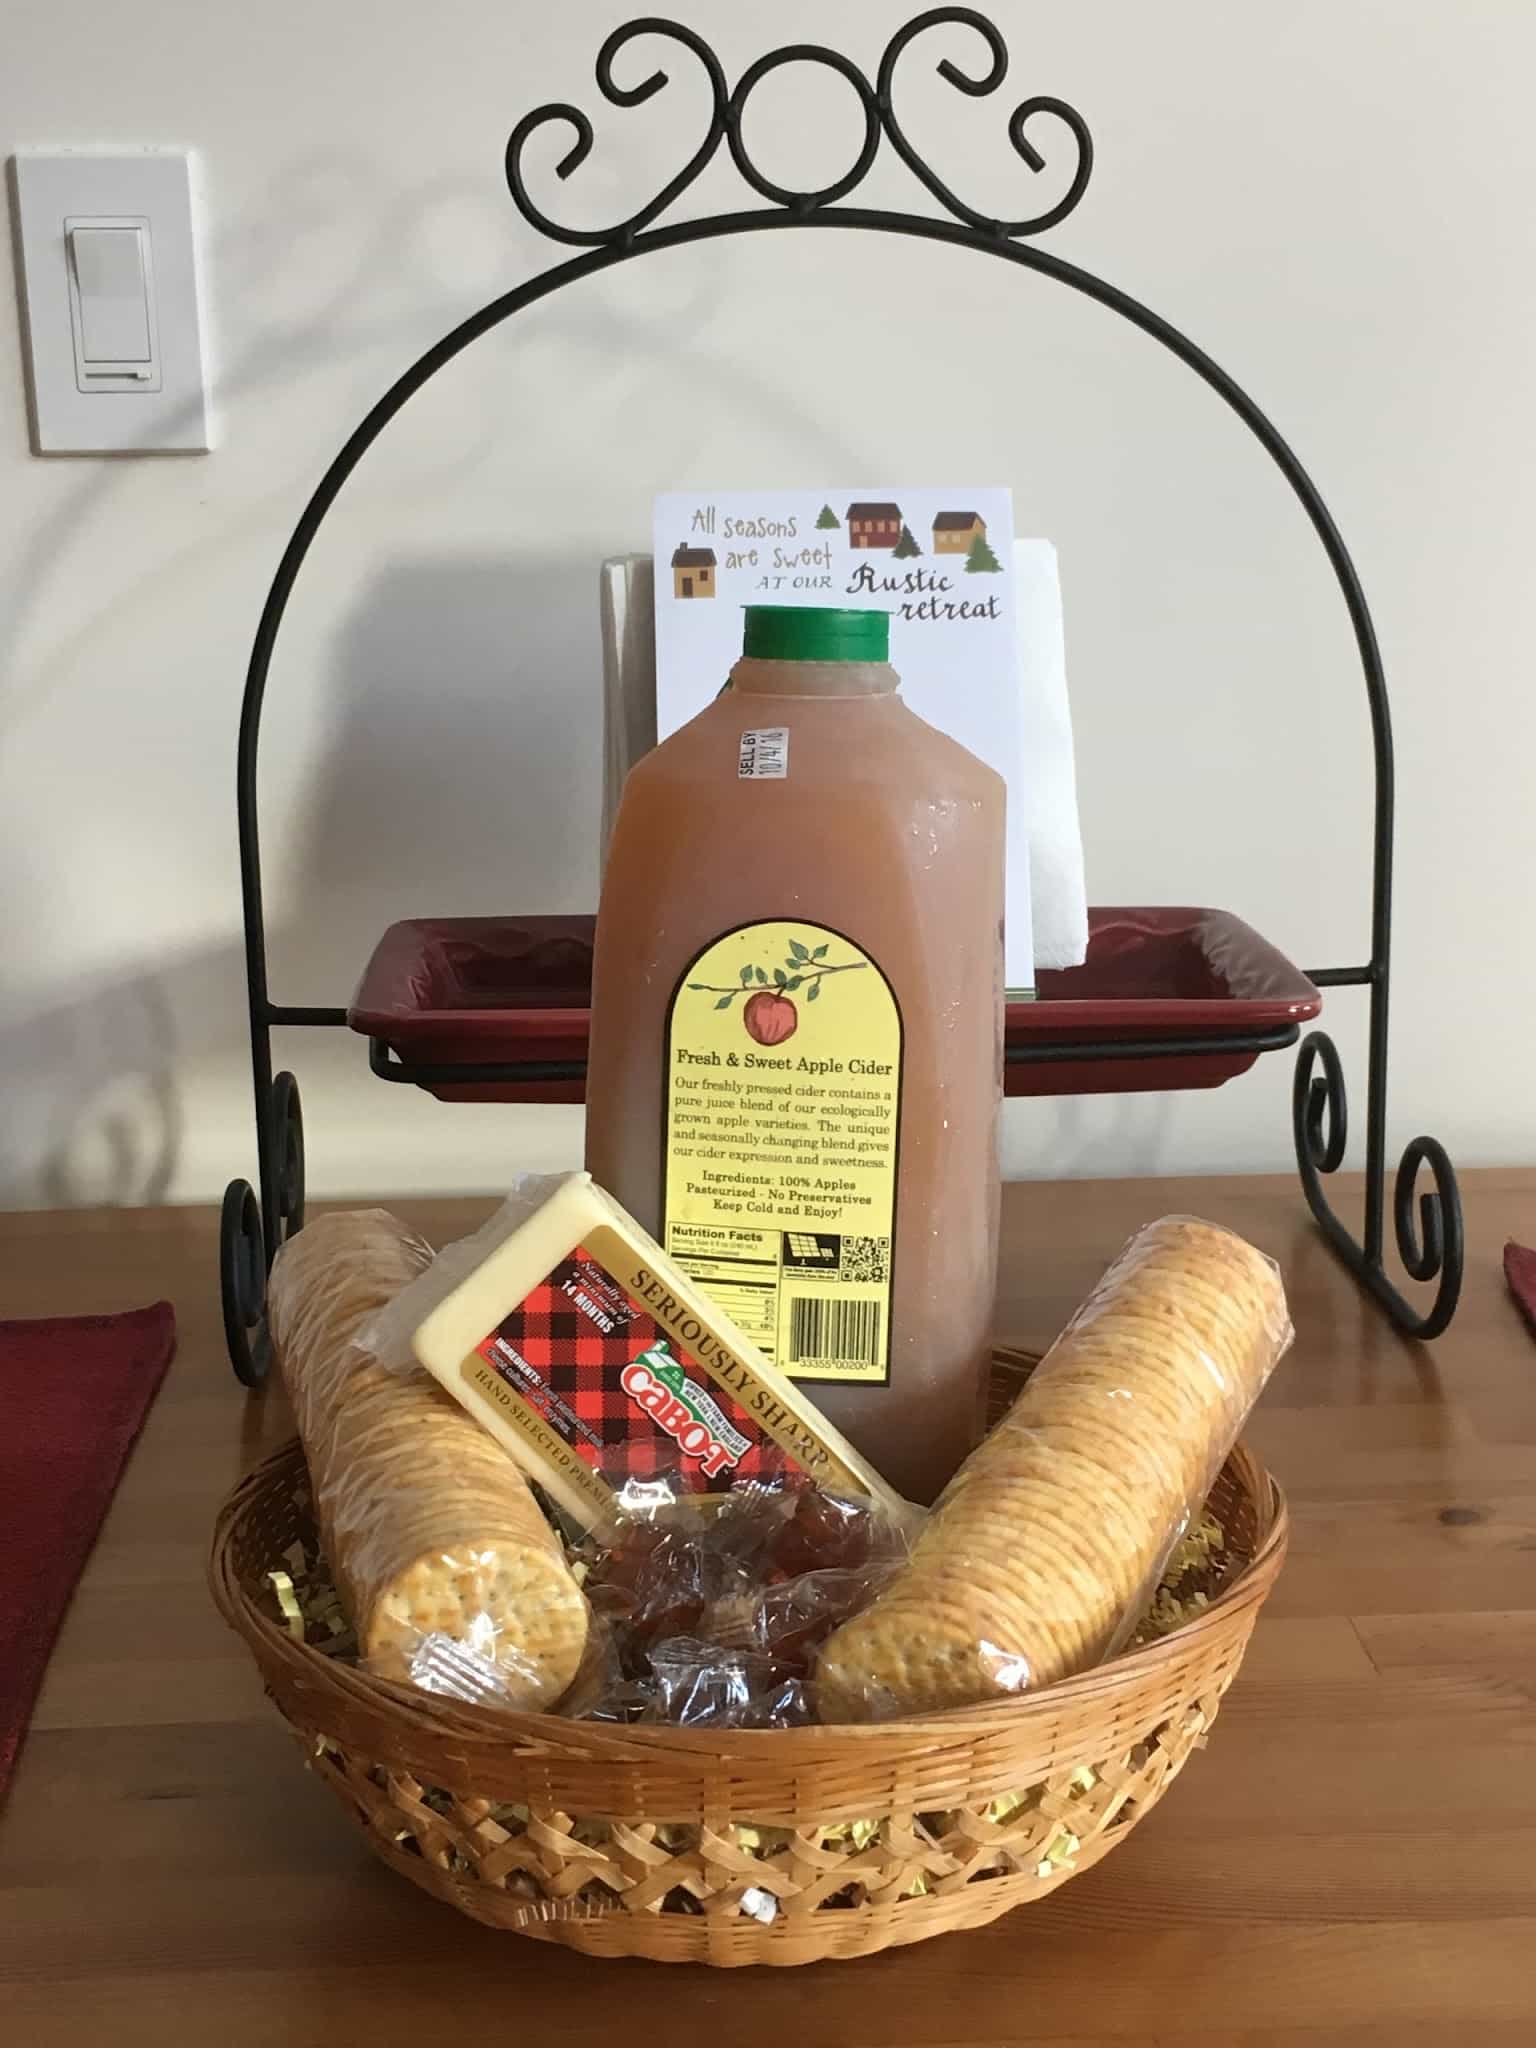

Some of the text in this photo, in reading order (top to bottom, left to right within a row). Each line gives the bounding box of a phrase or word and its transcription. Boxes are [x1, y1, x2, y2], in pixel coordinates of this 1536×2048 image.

[692, 505, 716, 534] All
[724, 516, 797, 539] seasons
[725, 552, 758, 569] are
[754, 575, 832, 590] AT OUR
[846, 561, 955, 594] Rustic
[896, 596, 1002, 621] retreat
[740, 732, 756, 775] SELL BY
[677, 1048, 893, 1075] Fresh & Sweet Apple Cider
[675, 1076, 891, 1100] Our freshly pressed cider contains a
[675, 1096, 891, 1119] pure juice blend of our ecologically
[674, 1112, 711, 1124] grown
[716, 1114, 750, 1128] apple
[817, 1119, 841, 1132] The
[847, 1122, 890, 1136] unique
[674, 1128, 889, 1152] and seasonally changing blend gives
[673, 1146, 693, 1156] our
[696, 1146, 726, 1158] cider
[728, 1151, 792, 1162] expression
[795, 1153, 819, 1165] and
[703, 1169, 856, 1191] Ingredients: 100% Apples
[686, 1182, 756, 1198] Pasteurized
[768, 1188, 785, 1200] No
[789, 1190, 872, 1204] Preservatives
[713, 1199, 842, 1219] Keep Cold and Enjoy!
[672, 1226, 763, 1242] Nutrition Facts
[559, 1277, 614, 1333] 14 MONTHS
[631, 1269, 754, 1393] SERIOUSLY
[751, 1391, 830, 1470] SHARP
[475, 1369, 620, 1517] HAND SELECTED PREMI
